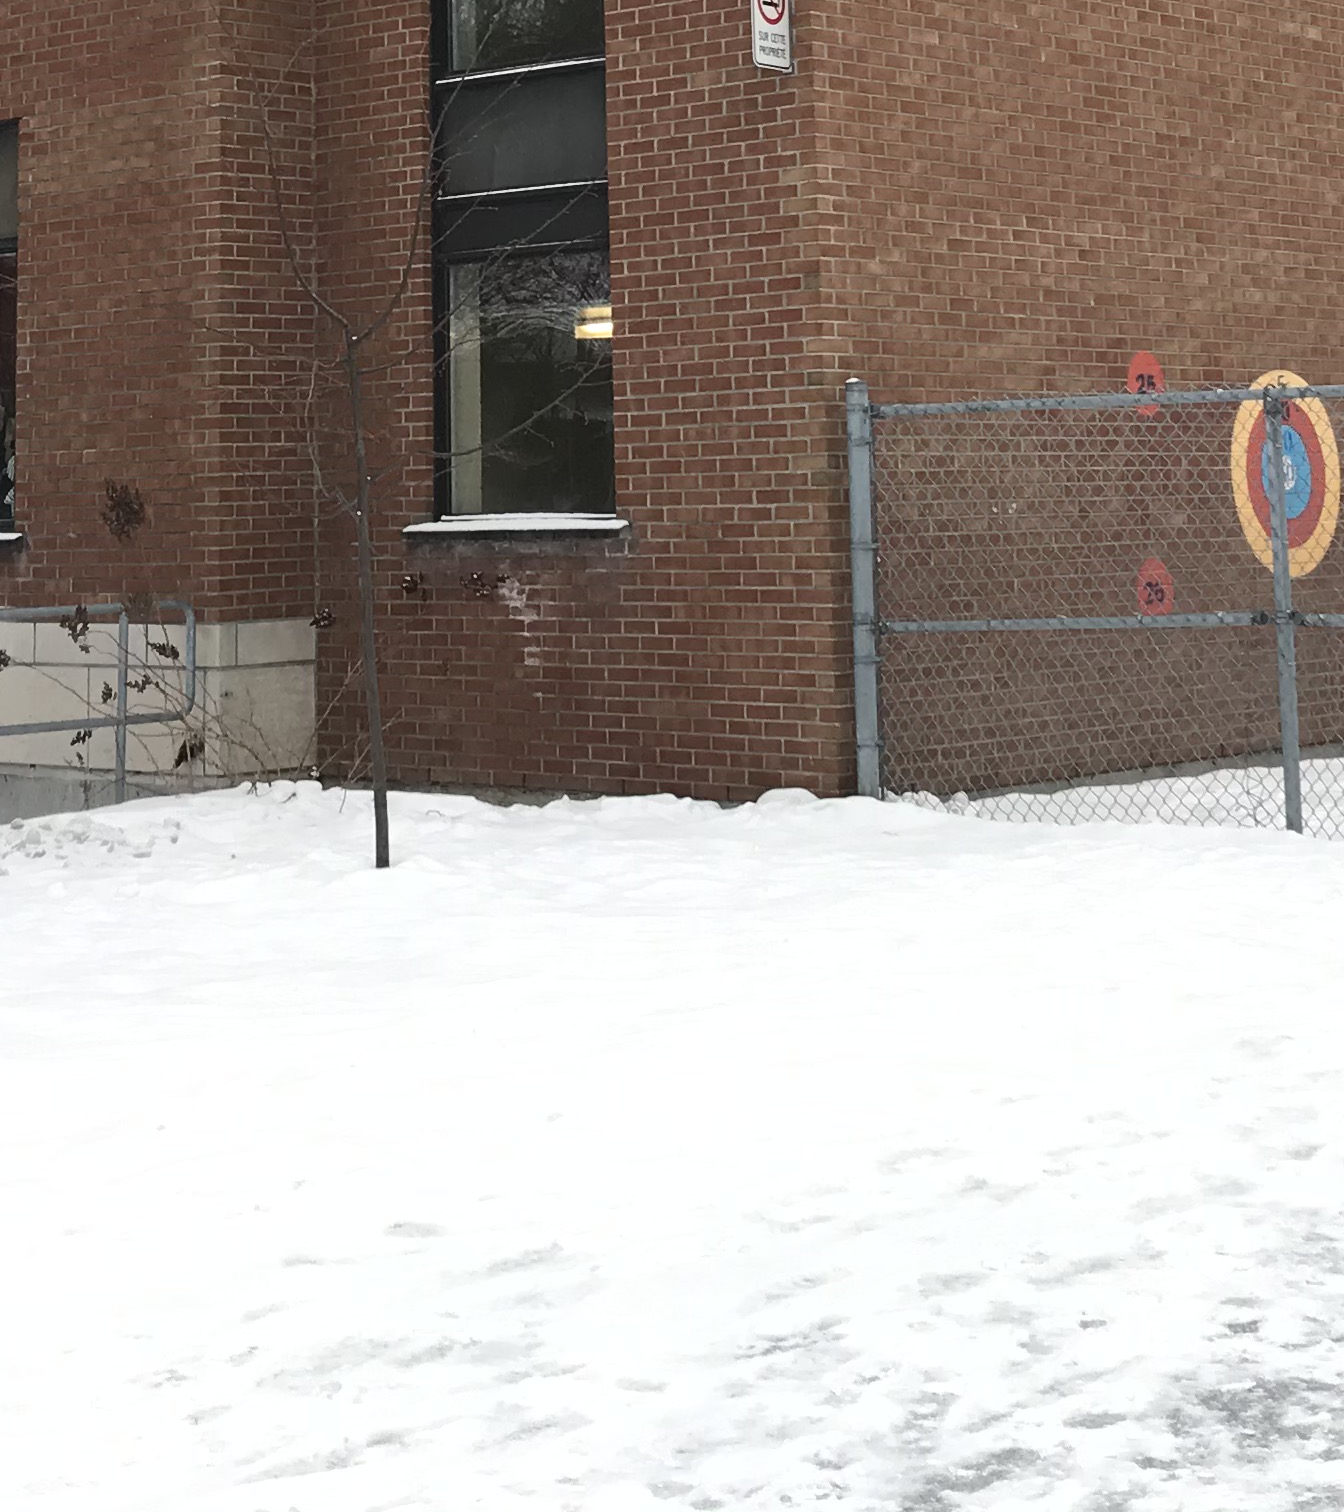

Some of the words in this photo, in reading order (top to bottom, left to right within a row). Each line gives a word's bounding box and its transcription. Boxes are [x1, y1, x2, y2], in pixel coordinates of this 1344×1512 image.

[759, 31, 769, 41] SUR
[771, 33, 786, 45] CETTE
[1135, 373, 1156, 394] 25
